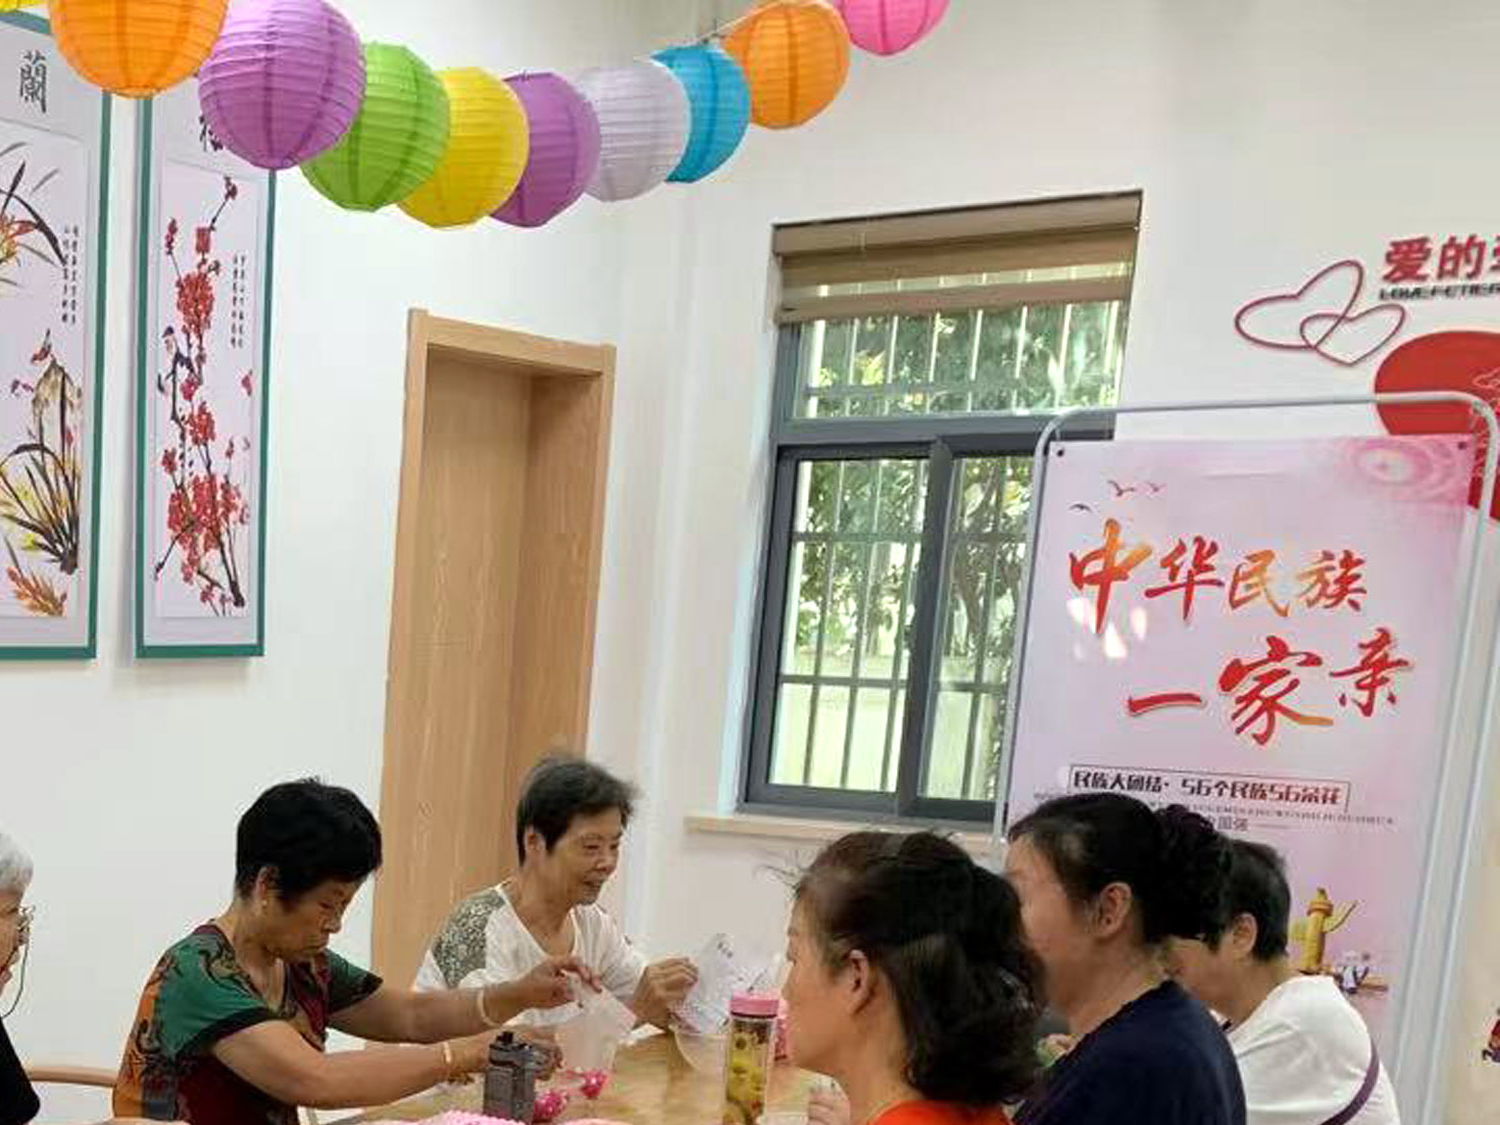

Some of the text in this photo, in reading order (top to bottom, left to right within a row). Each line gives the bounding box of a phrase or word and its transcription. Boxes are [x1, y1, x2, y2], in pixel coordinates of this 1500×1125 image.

[19, 50, 48, 114] 蘭
[1069, 518, 1368, 635] 中华民族
[1126, 628, 1412, 745] 一家亲
